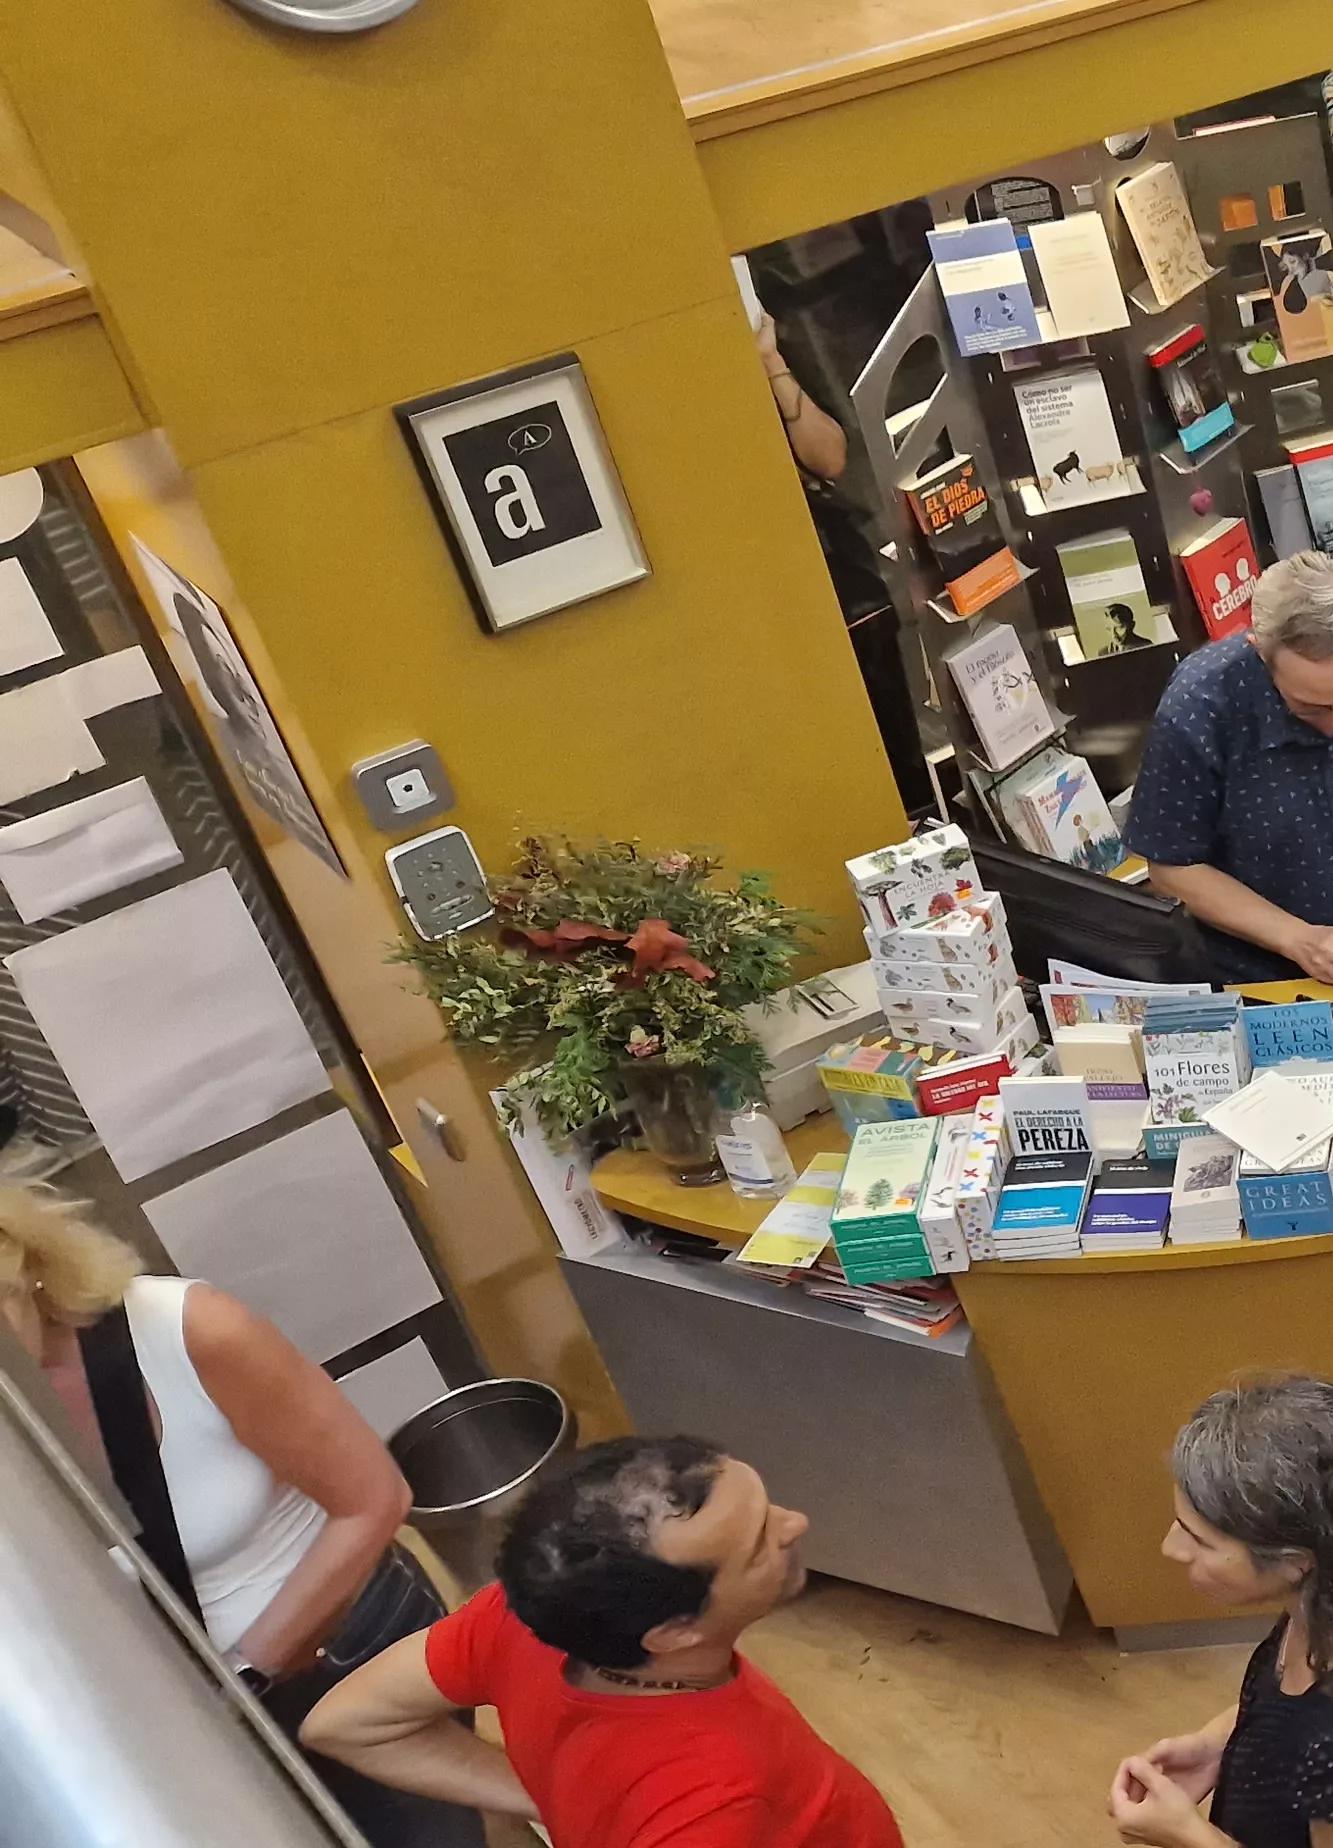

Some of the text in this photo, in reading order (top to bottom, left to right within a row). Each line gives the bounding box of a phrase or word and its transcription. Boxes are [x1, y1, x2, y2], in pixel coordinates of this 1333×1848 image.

[522, 430, 540, 446] A
[482, 462, 548, 541] a
[924, 478, 969, 514] EL DIOS
[930, 486, 986, 528] DE PIEDRA
[1212, 574, 1258, 620] CEREBRO
[1272, 1008, 1299, 1018] LOS
[1250, 1016, 1328, 1031] MODERNOS
[1252, 1028, 1330, 1046] LEEN
[1255, 1042, 1333, 1058] CLÁSICOS
[1177, 1060, 1231, 1076] Flores
[1176, 1078, 1230, 1088] de campo
[861, 1122, 930, 1138] AVISTA
[1014, 1117, 1024, 1128] EL
[1026, 1116, 1064, 1128] DERECHO
[1074, 1116, 1085, 1127] LA
[1018, 1128, 1090, 1152] PEREZA
[1156, 1142, 1174, 1151] DE
[1244, 1180, 1325, 1198] GREAT
[1248, 1193, 1328, 1212] IDEAS
